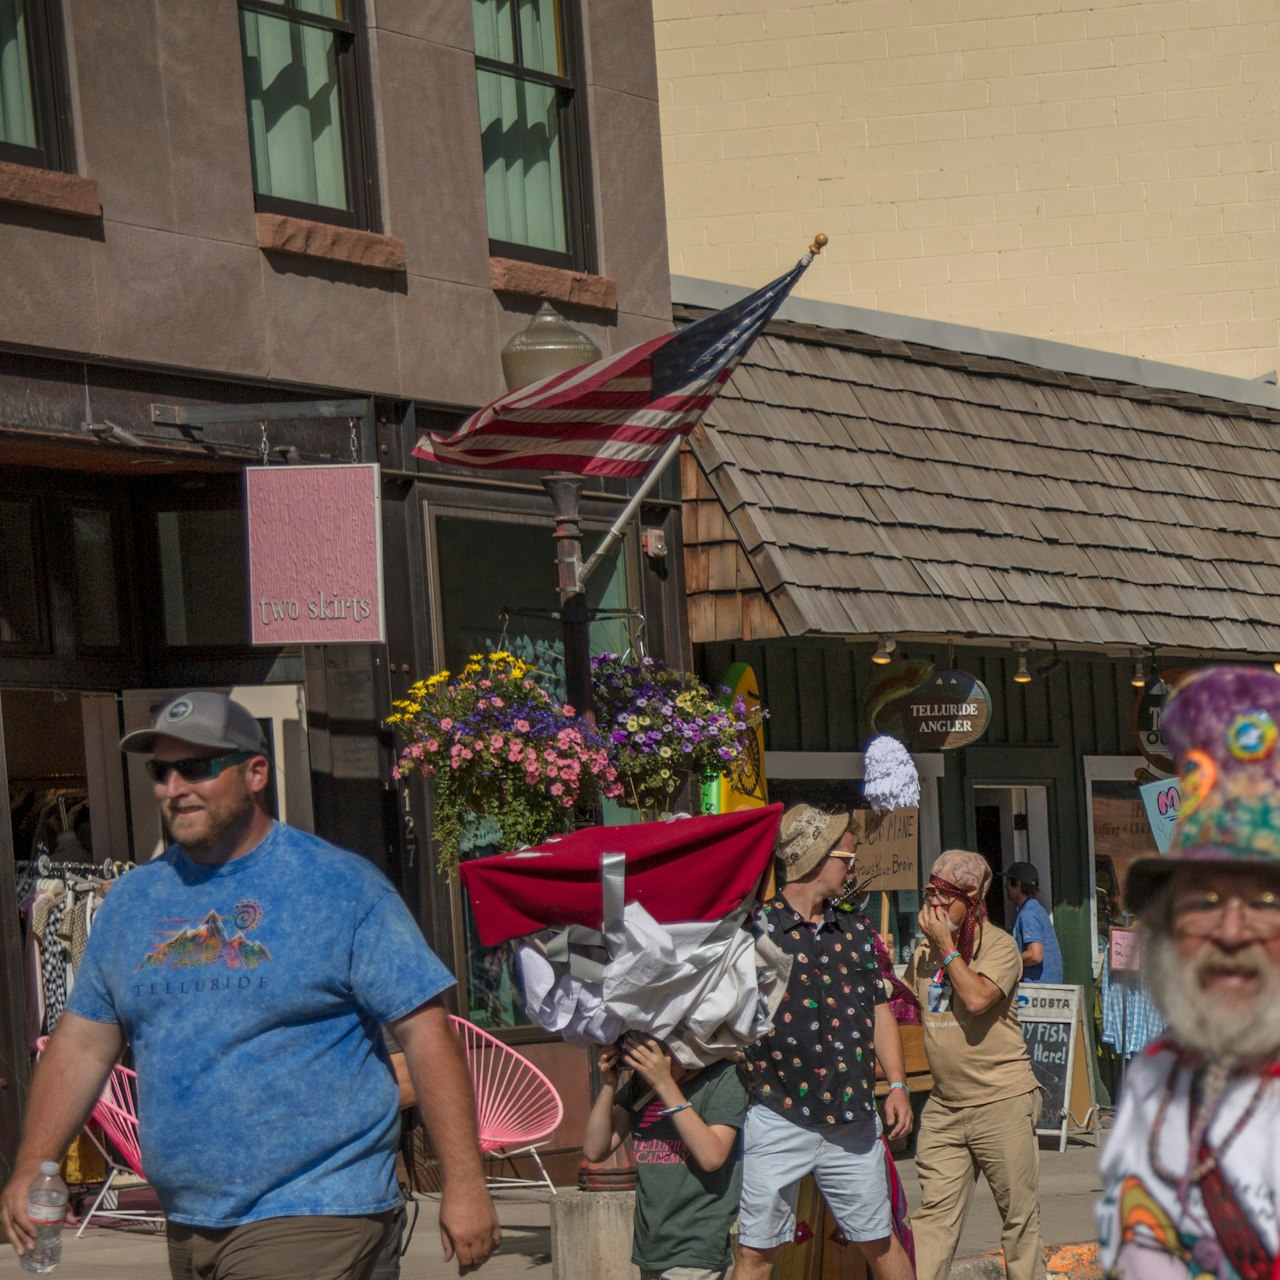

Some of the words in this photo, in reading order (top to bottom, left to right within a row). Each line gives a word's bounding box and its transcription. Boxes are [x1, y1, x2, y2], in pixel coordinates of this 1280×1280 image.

[260, 592, 300, 625] two
[307, 589, 371, 623] skirts
[911, 704, 978, 716] TELLURIDE
[919, 720, 973, 733] ANGLER
[403, 788, 416, 867] 127
[133, 976, 268, 997] TELLURIDE
[1031, 997, 1070, 1009] COSTA
[1037, 1022, 1068, 1043] Fish
[1033, 1043, 1066, 1065] Here!
